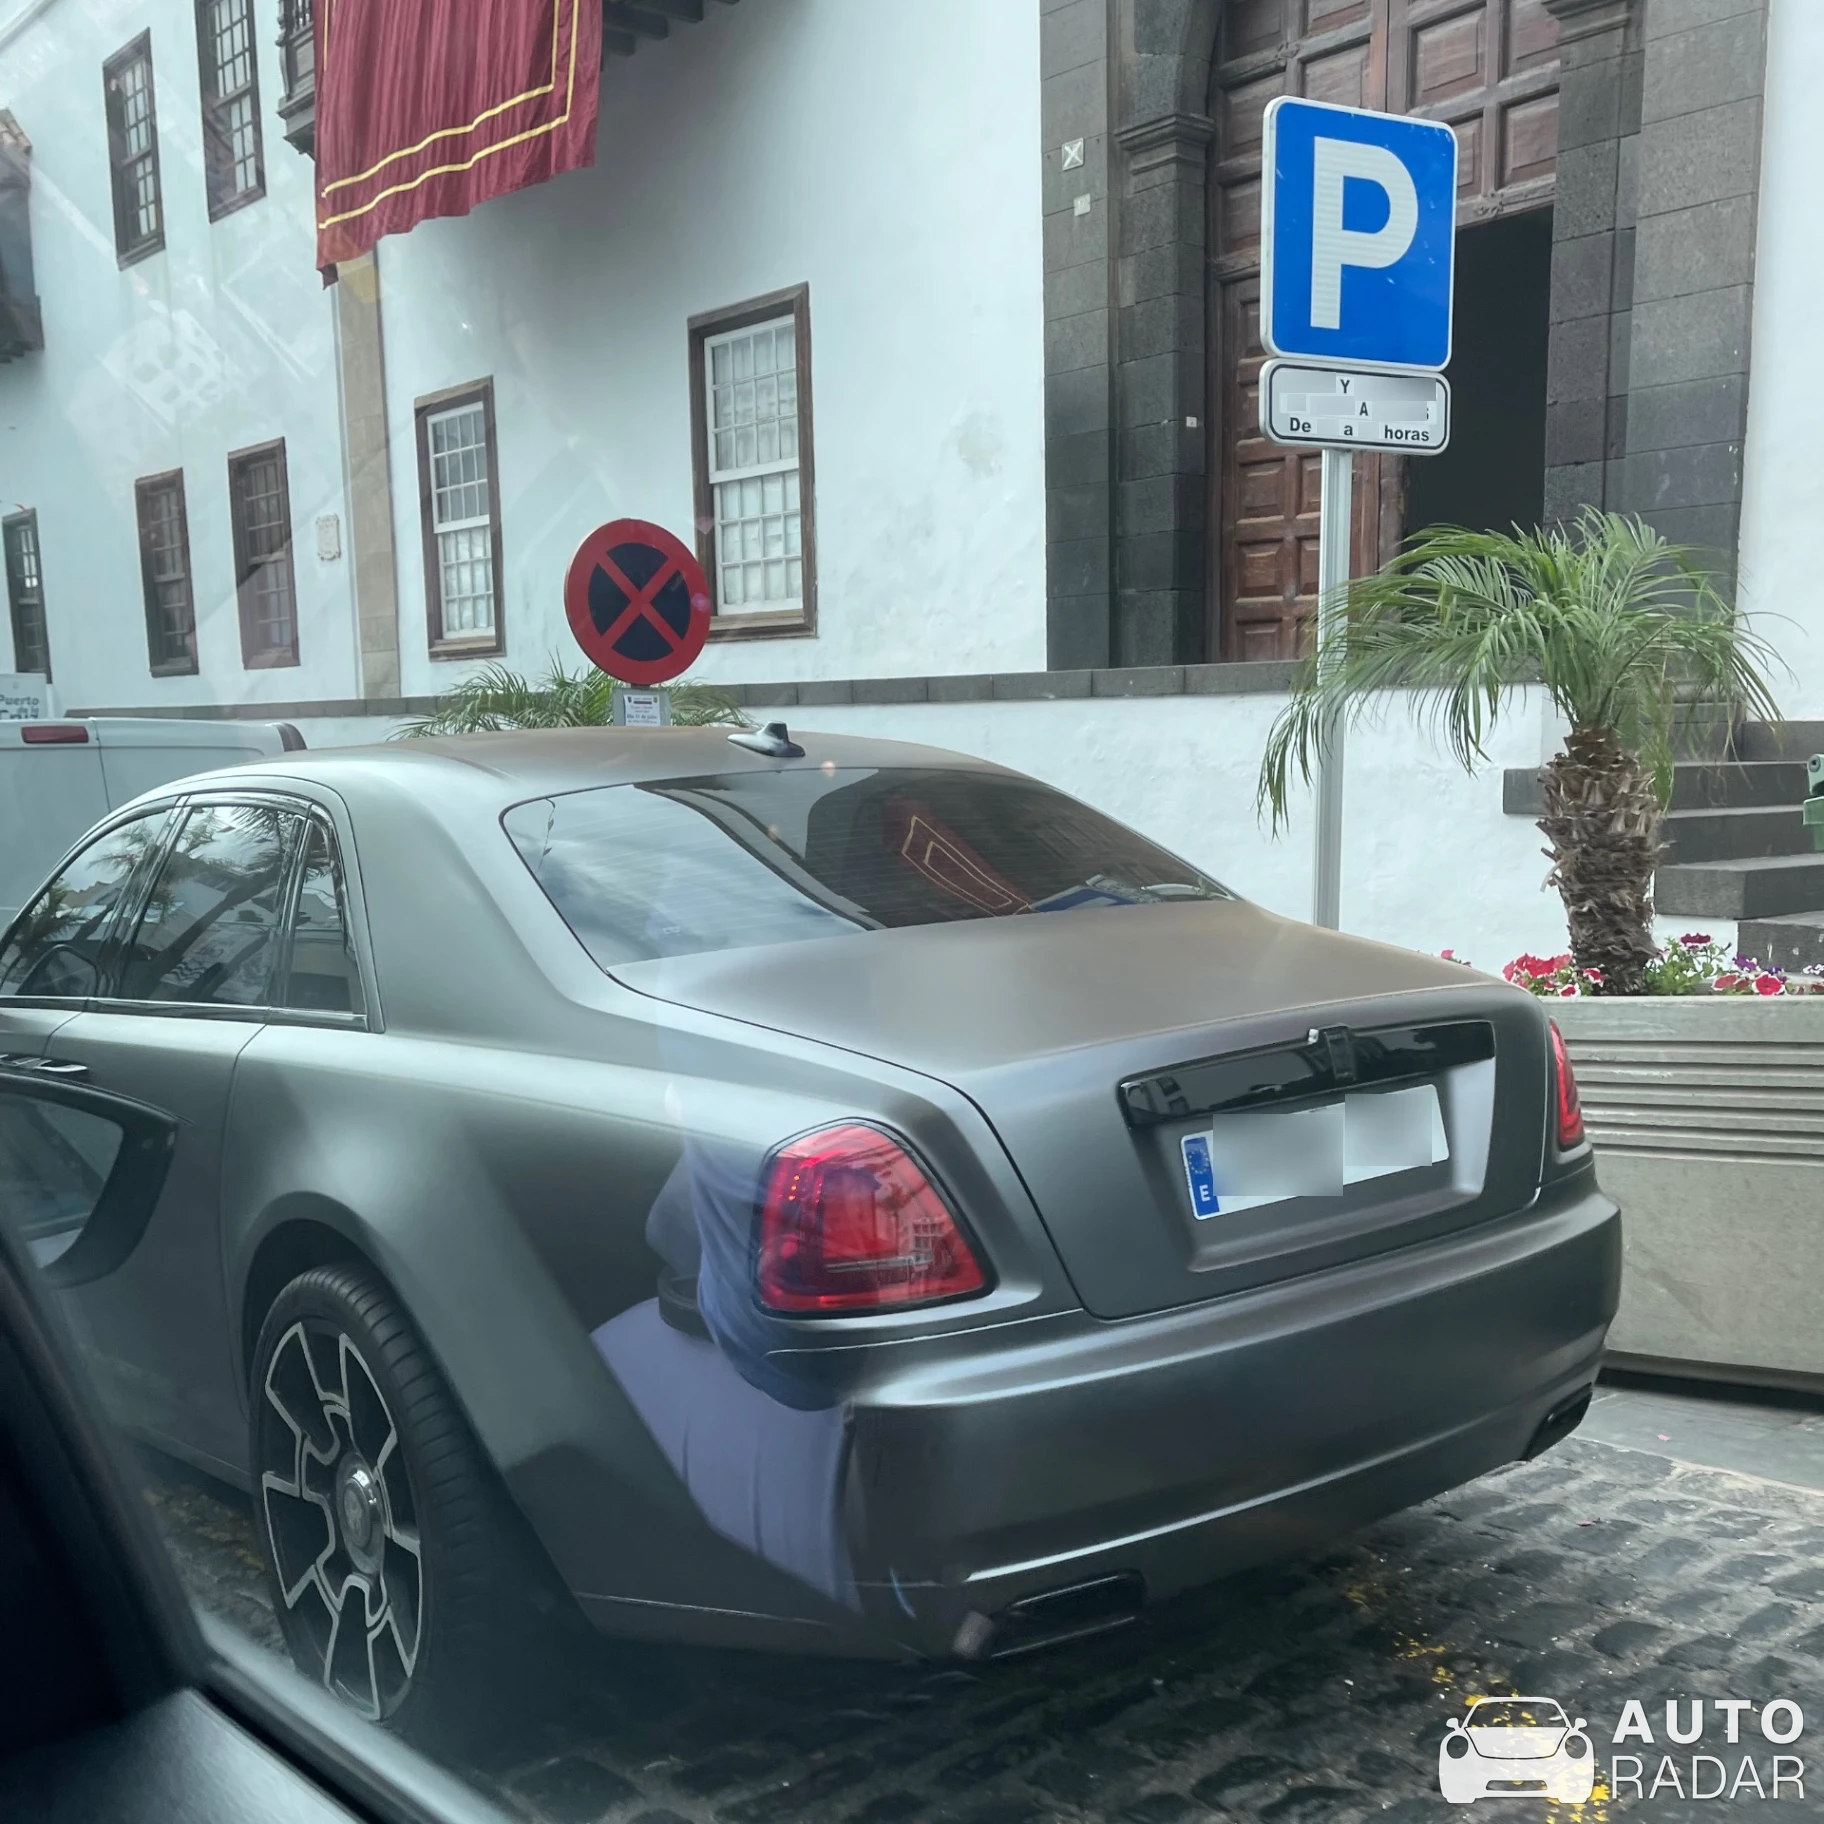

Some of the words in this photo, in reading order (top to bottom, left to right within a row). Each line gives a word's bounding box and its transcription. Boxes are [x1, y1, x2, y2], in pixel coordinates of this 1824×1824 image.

[1310, 135, 1418, 330] P
[1340, 379, 1350, 394] Y
[1359, 402, 1369, 416] A
[1290, 417, 1312, 432] De
[1344, 425, 1353, 436] a
[1384, 425, 1430, 441] horas
[1199, 1184, 1211, 1202] E
